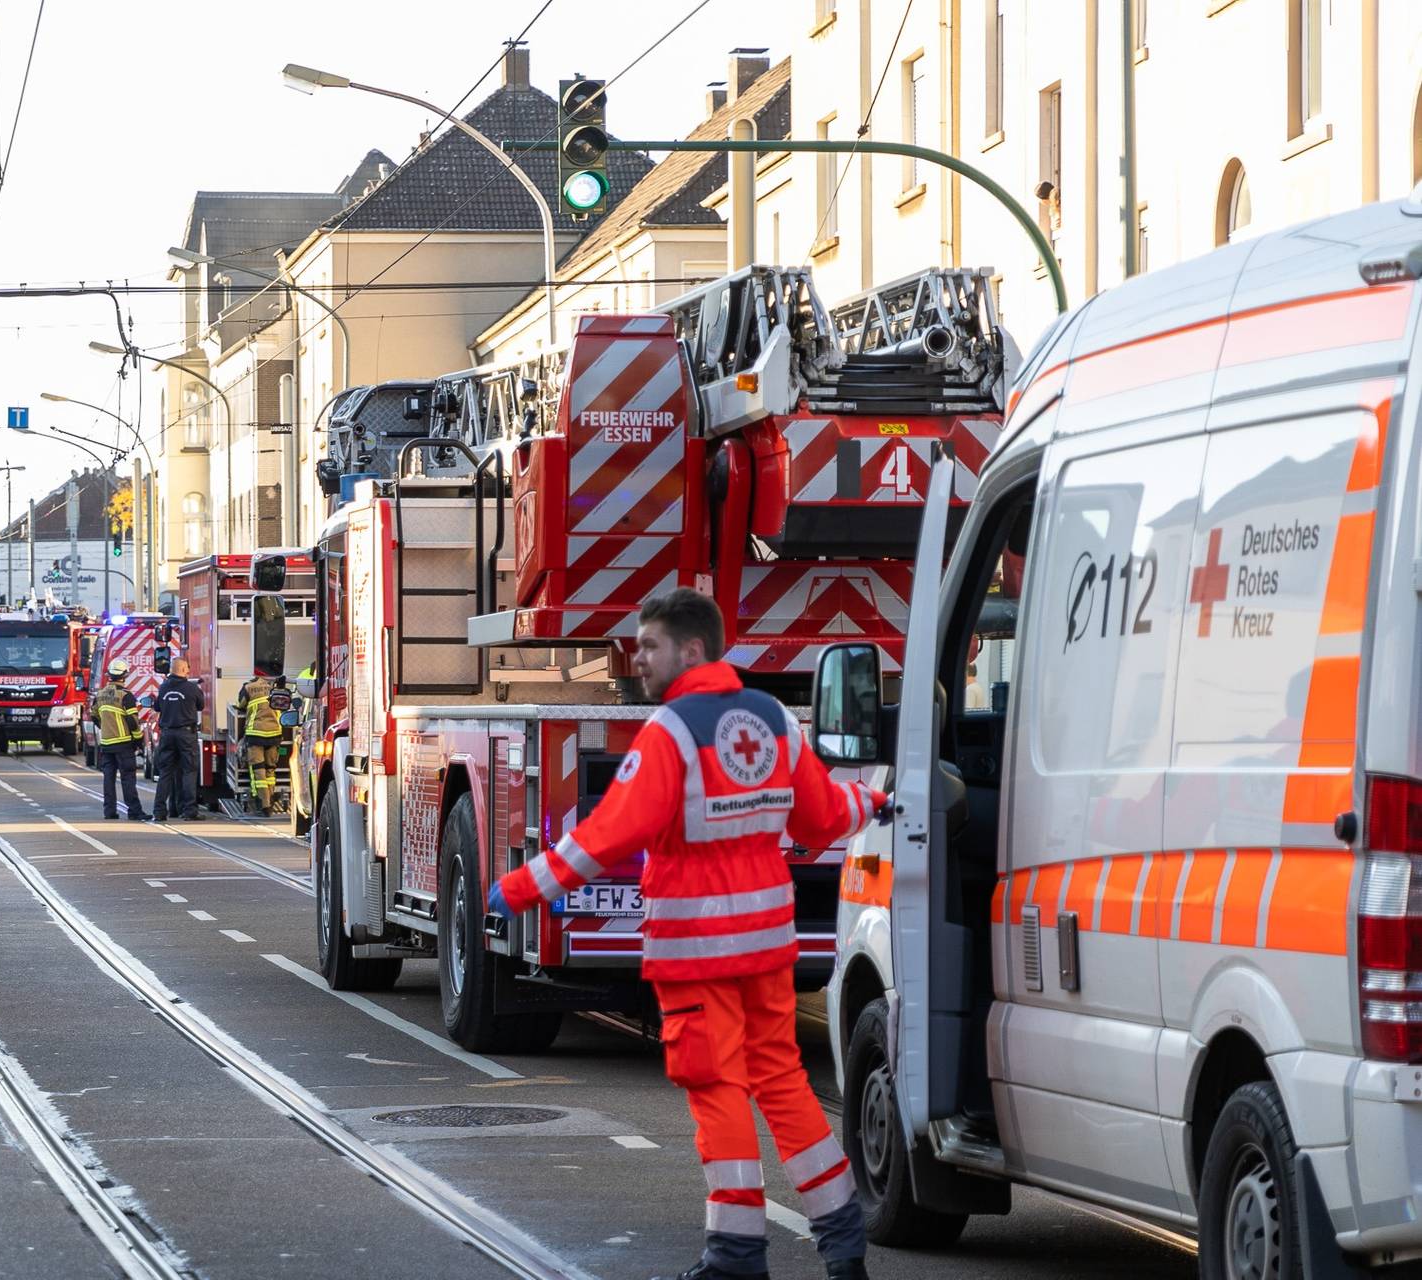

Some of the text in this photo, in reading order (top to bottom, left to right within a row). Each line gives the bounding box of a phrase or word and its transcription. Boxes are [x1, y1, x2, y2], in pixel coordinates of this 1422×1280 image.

[580, 411, 675, 427] FEUERWEHR
[604, 427, 652, 442] ESSEN
[881, 446, 911, 492] 4
[1241, 518, 1321, 556] Deutsches
[1099, 548, 1158, 638] 112
[1235, 565, 1280, 598] Rotes
[1231, 606, 1275, 638] Kreuz
[0, 676, 47, 685] FEUERWEHR
[721, 714, 770, 740] DEUTSCHES
[723, 747, 774, 782] ROTES KREUZ
[711, 793, 793, 813] Rettungsdienst
[567, 888, 580, 909] E
[596, 888, 624, 909] FW
